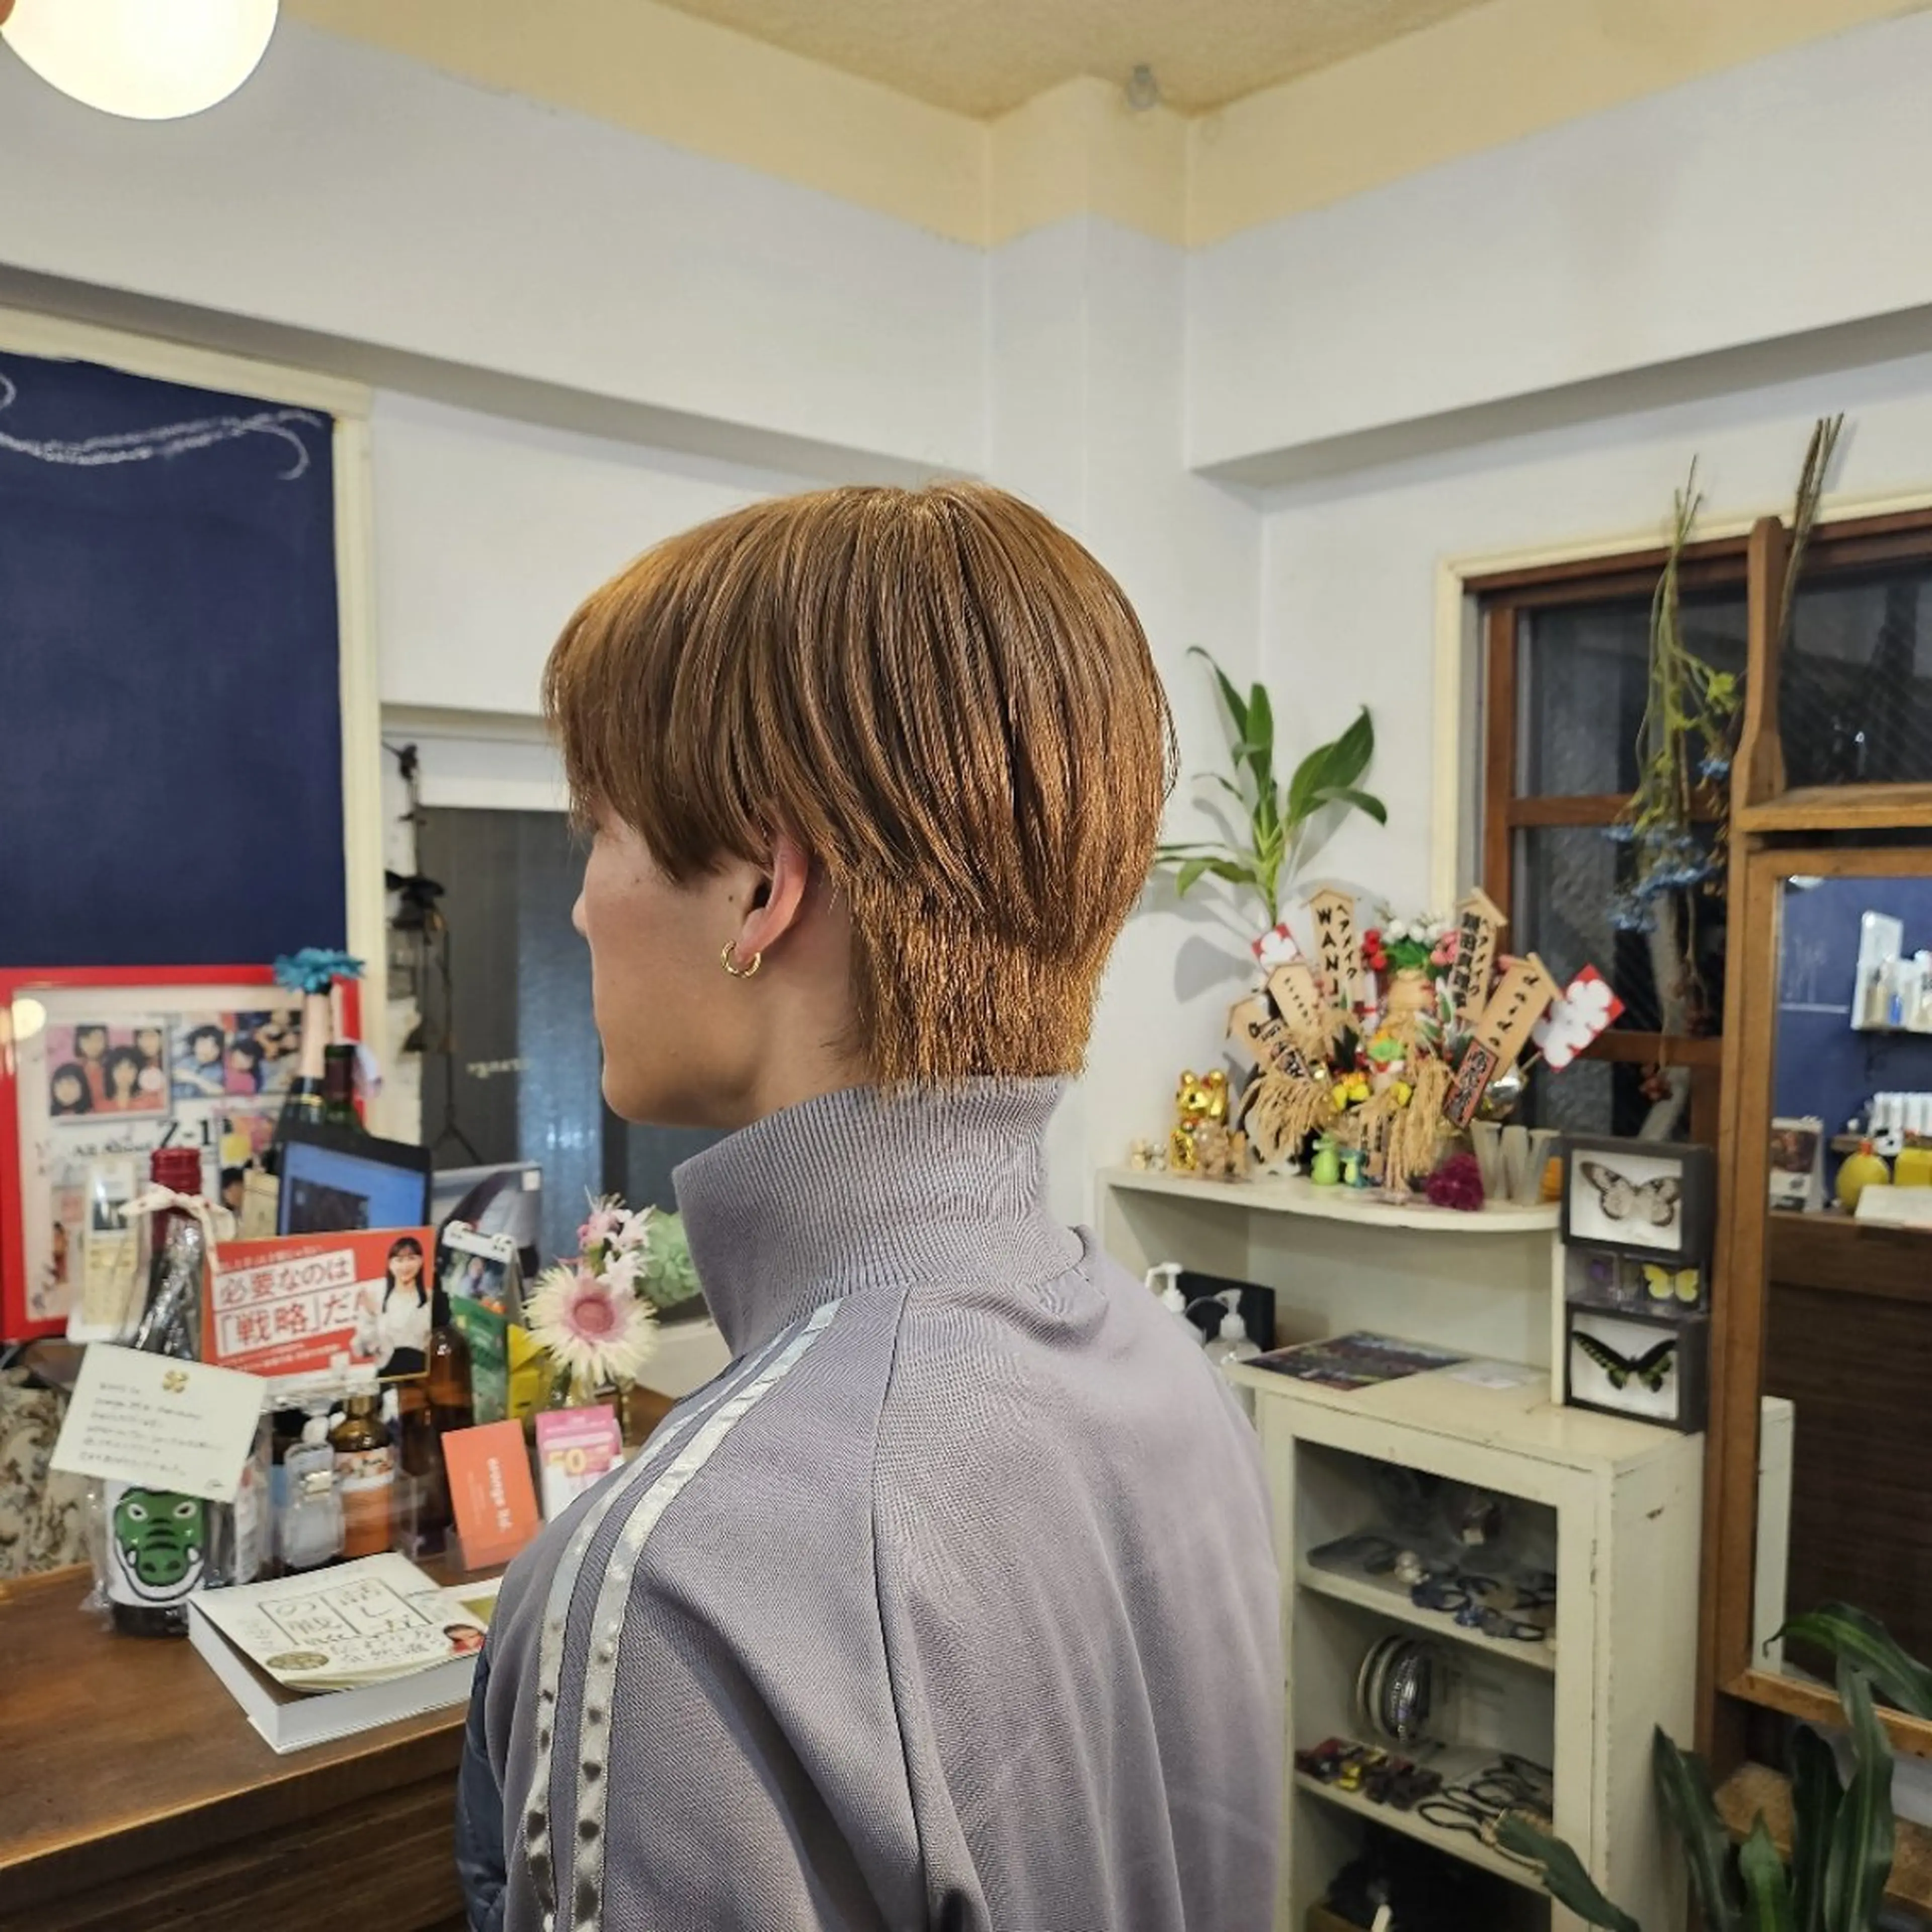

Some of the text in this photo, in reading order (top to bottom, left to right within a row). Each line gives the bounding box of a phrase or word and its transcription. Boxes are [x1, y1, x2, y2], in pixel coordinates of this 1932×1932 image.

[1316, 907, 1339, 1008] WANJ
[220, 1256, 350, 1306] 必要なのは
